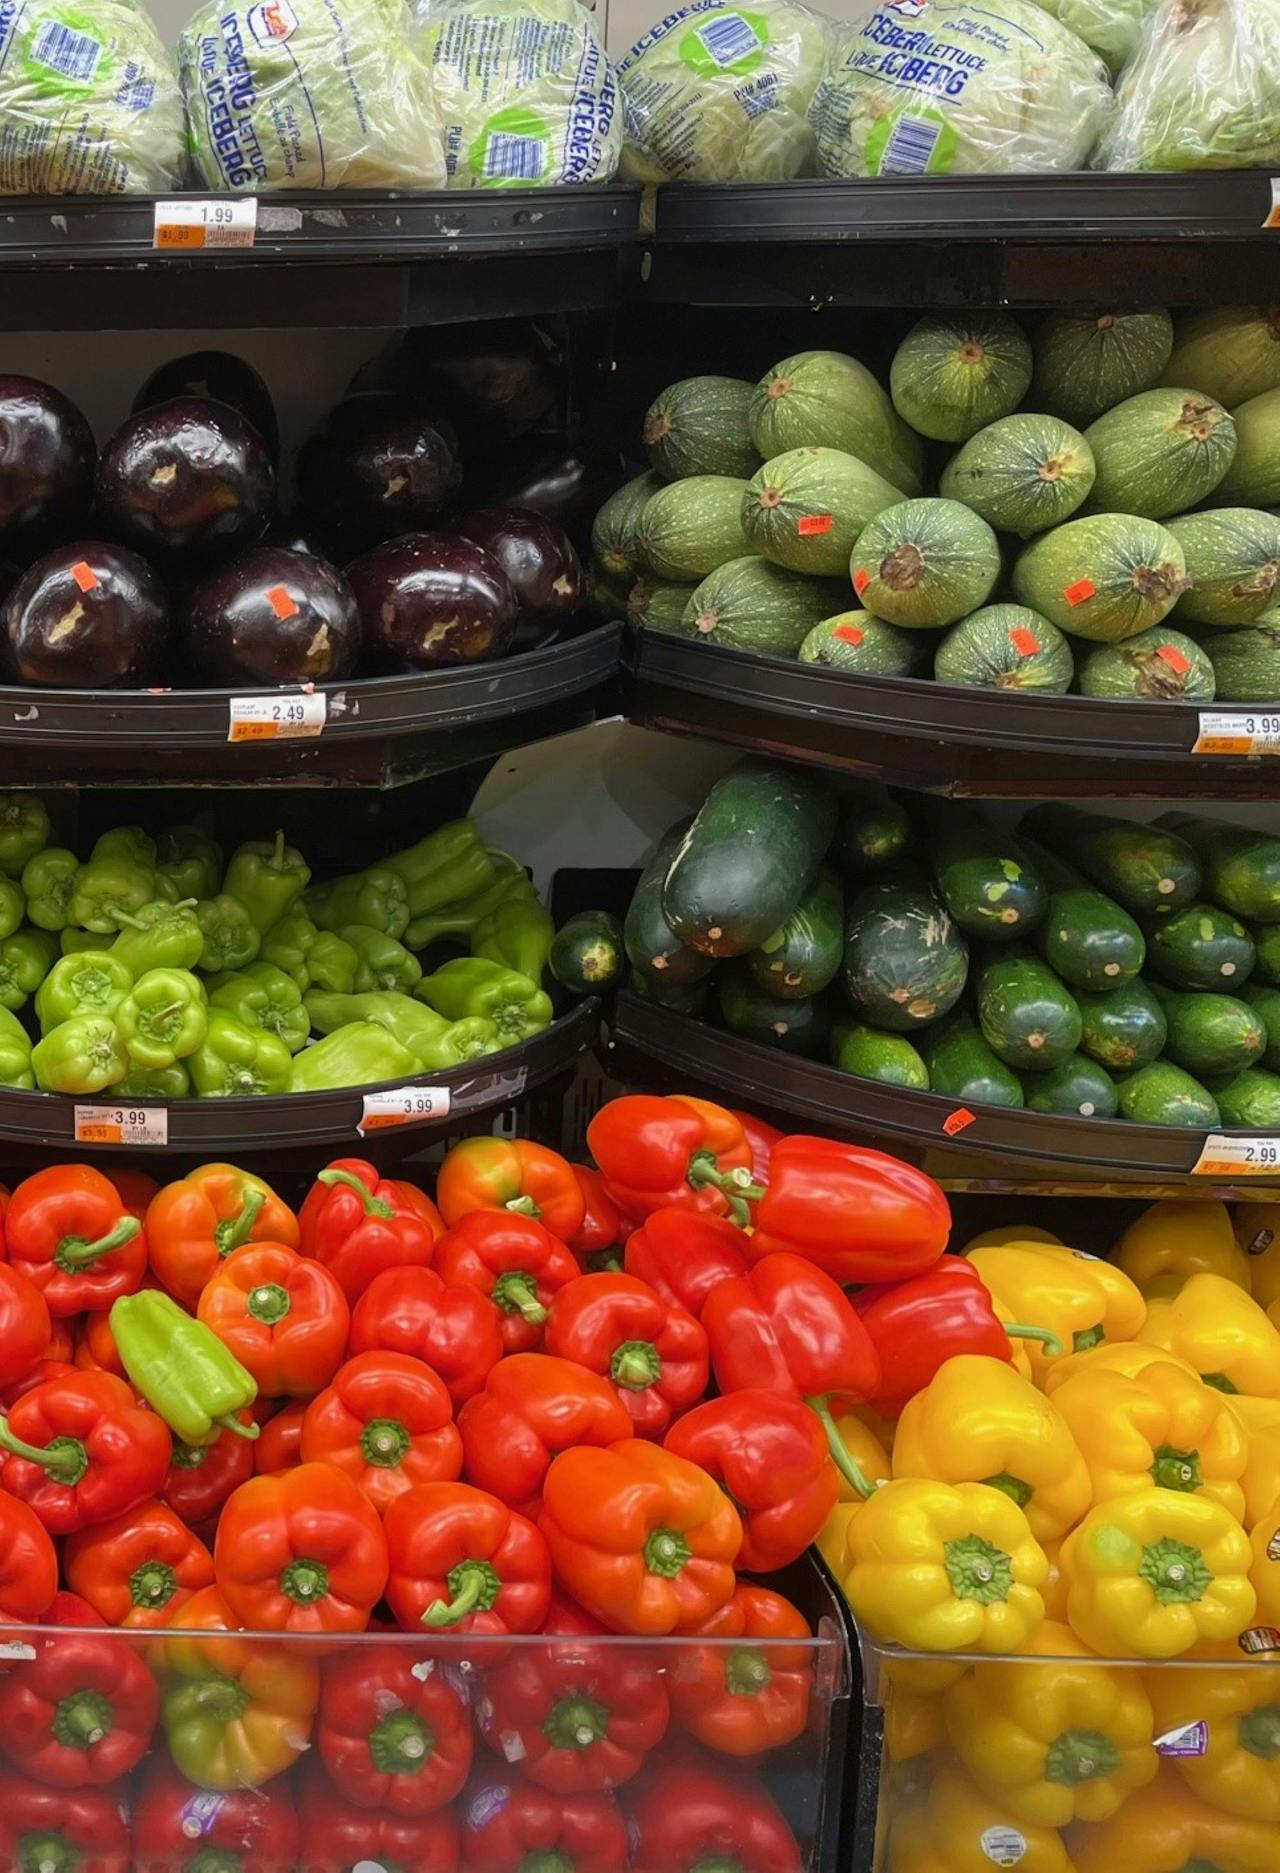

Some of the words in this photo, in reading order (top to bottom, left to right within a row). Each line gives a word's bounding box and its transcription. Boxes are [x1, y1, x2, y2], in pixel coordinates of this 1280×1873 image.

[221, 12, 257, 111] ICEBERG
[925, 43, 990, 72] LETTUCE
[206, 76, 251, 188] ICEBERG
[201, 207, 233, 223] 1.99
[272, 705, 304, 721] 2.49
[1246, 717, 1280, 734] 3.99
[404, 1098, 433, 1113] 3.99
[115, 1111, 146, 1125] 3.99
[1245, 1147, 1277, 1162] 2.99
